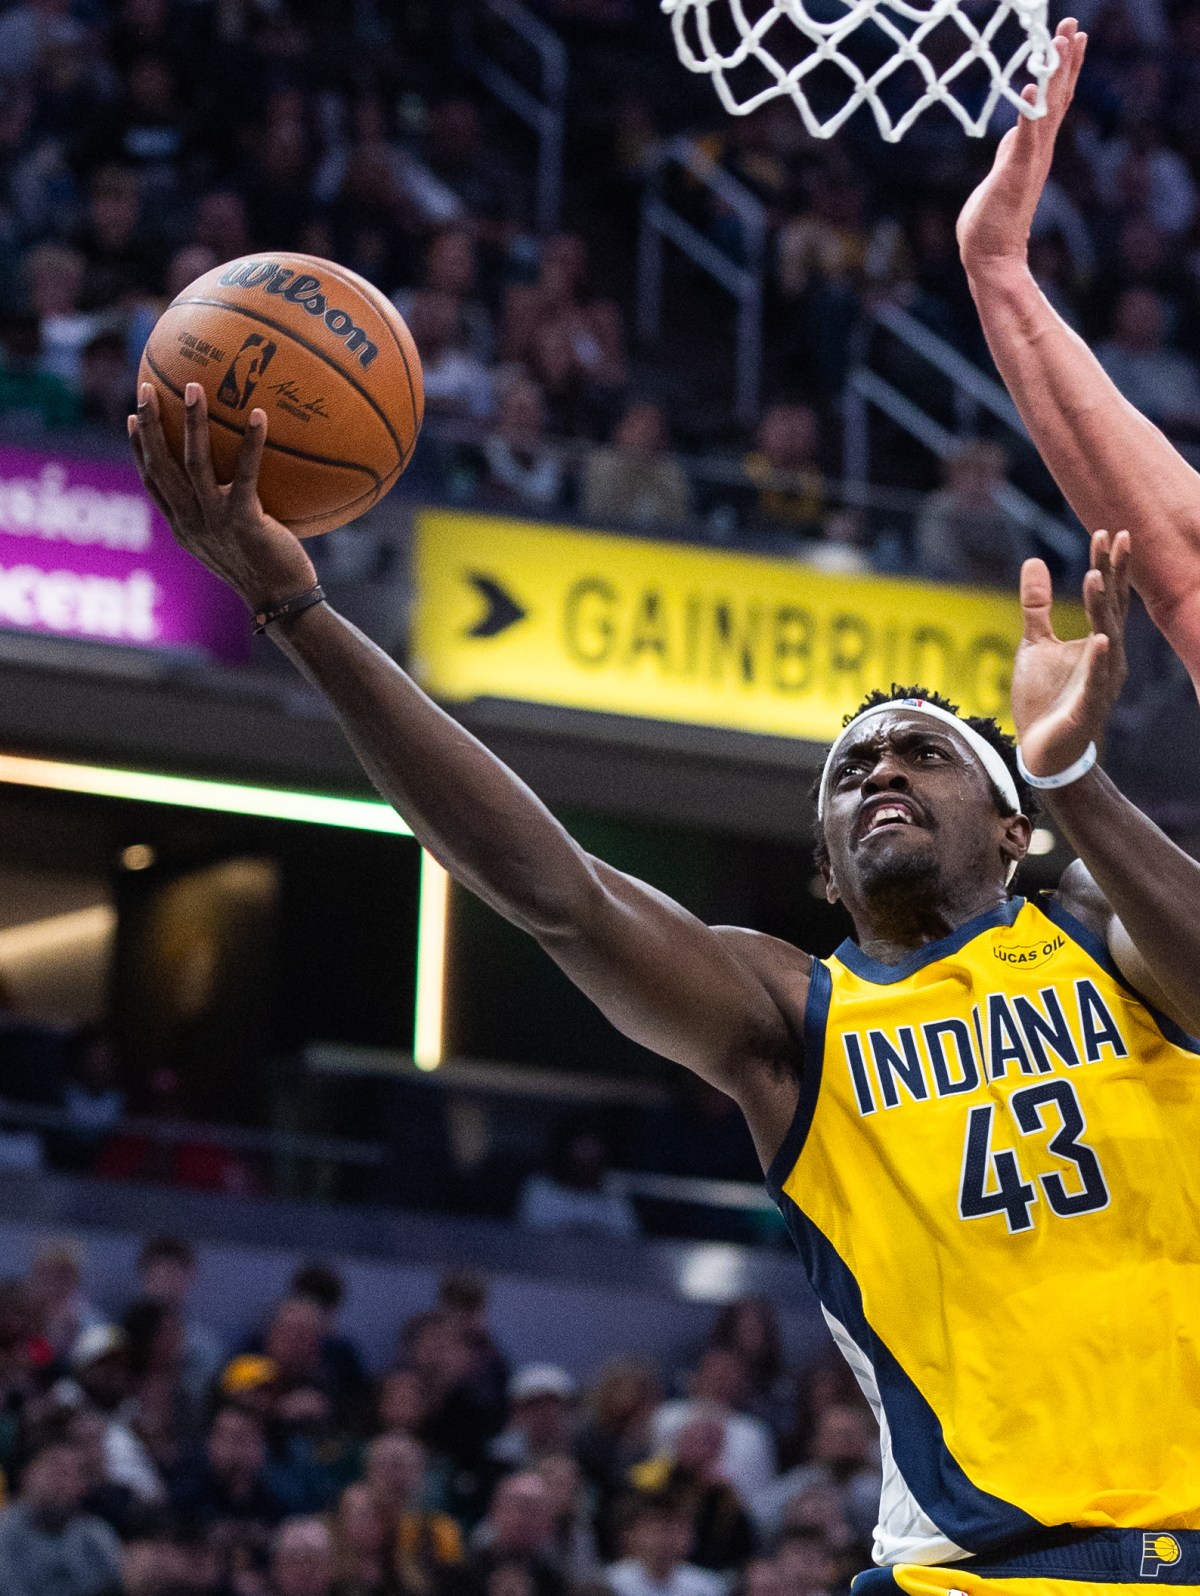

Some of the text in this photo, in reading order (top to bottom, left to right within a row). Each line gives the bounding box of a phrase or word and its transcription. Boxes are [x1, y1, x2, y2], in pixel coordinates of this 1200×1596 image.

[217, 261, 380, 371] Wilson
[0, 563, 160, 642] cent
[993, 935, 1066, 963] LUCAS OIL
[841, 977, 1130, 1118] INDIANA
[957, 1076, 1113, 1236] 43
